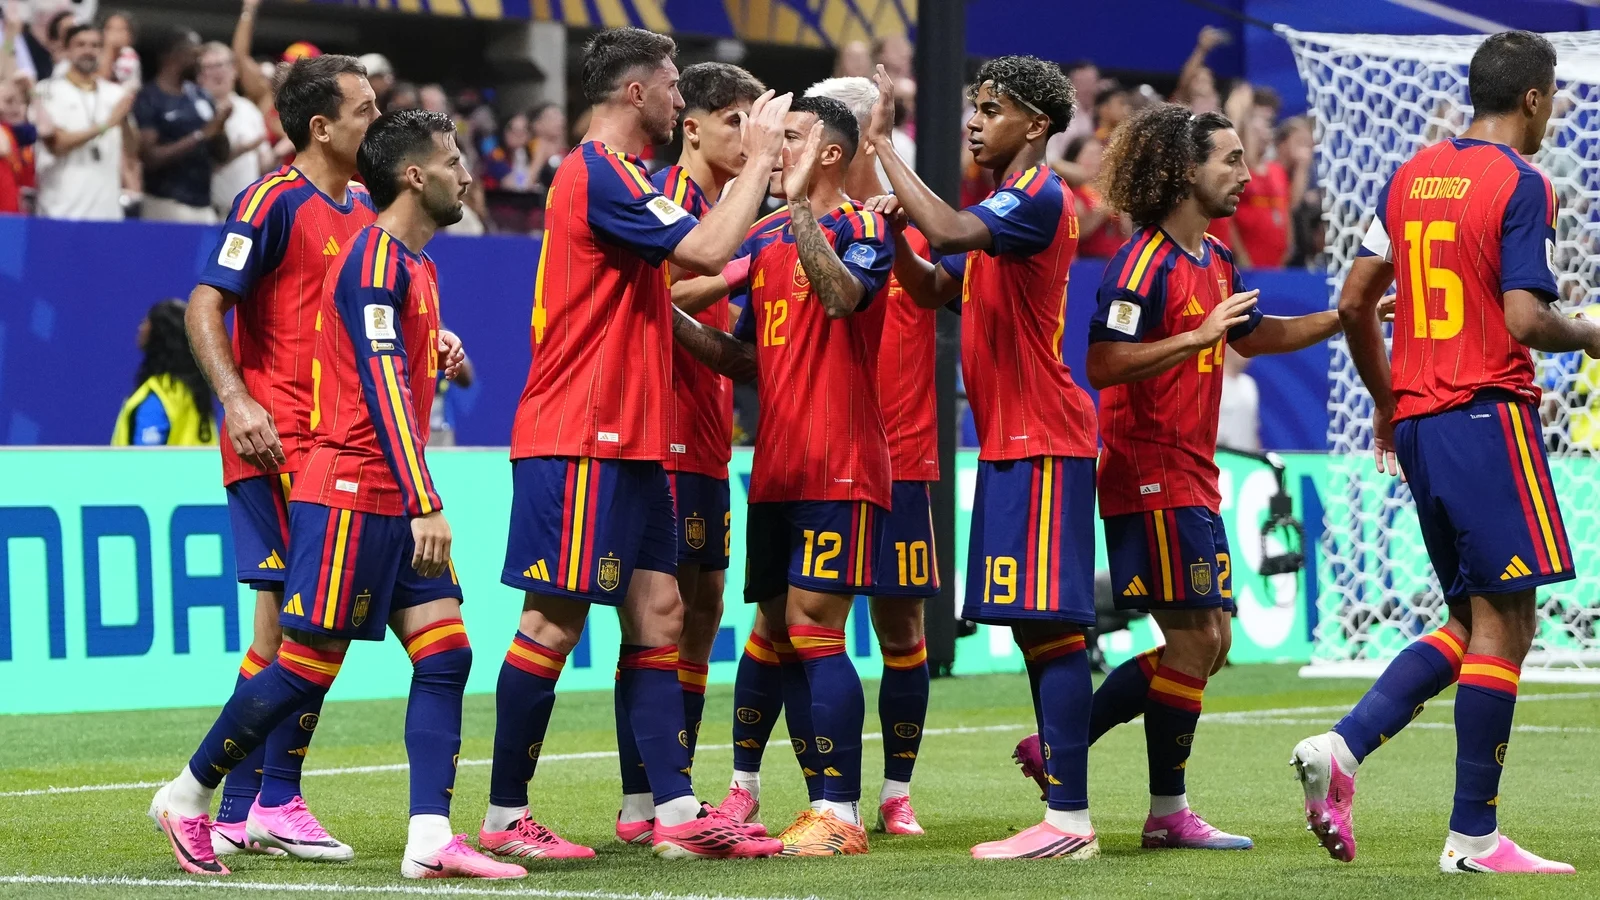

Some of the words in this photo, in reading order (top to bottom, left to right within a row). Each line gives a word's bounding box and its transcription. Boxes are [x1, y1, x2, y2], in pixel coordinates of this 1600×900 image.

[1409, 176, 1471, 200] RODRIGO
[1404, 220, 1464, 340] 16
[763, 299, 788, 347] 12
[801, 529, 843, 580] 12
[895, 540, 929, 587] 10
[983, 555, 1018, 604] 19
